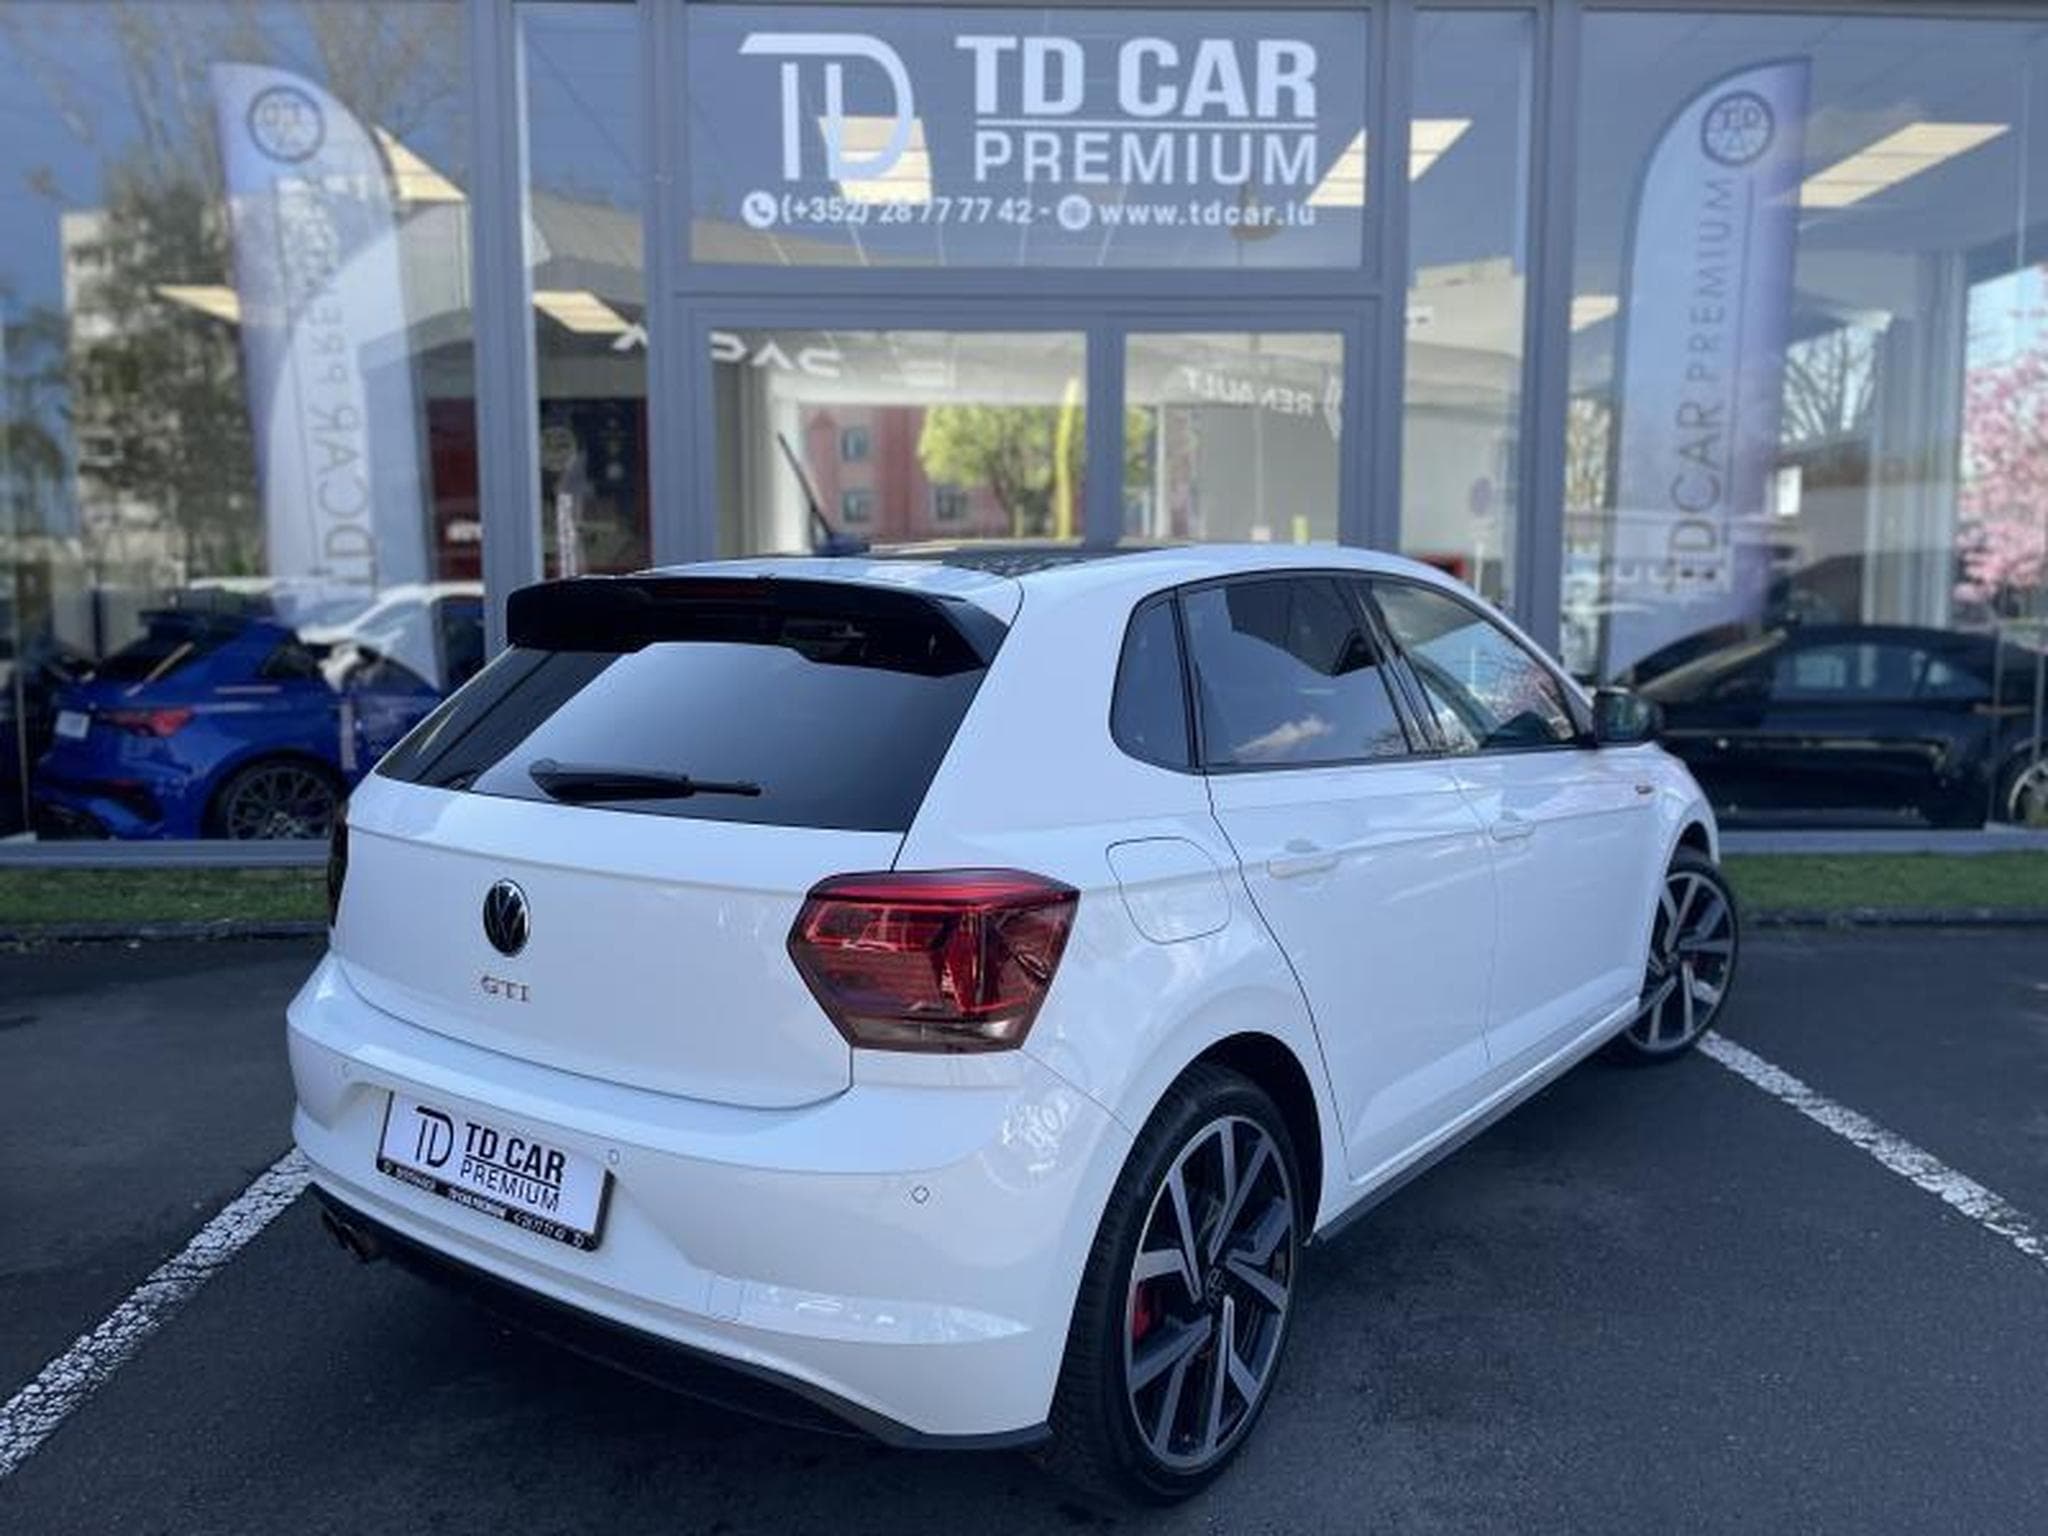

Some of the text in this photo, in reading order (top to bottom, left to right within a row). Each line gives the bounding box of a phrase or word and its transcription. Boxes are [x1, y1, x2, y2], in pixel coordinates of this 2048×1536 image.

[955, 36, 1318, 118] TD CAR
[974, 131, 1318, 185] PREMIUM
[957, 196, 993, 223] 77
[998, 198, 1033, 225] 42
[1098, 200, 1317, 227] www.tdcar.lu
[1687, 176, 1736, 383] PREMIUM
[480, 974, 531, 1003] GTI
[465, 1122, 566, 1184] TD CAR
[459, 1159, 560, 1213] PREMIUM
